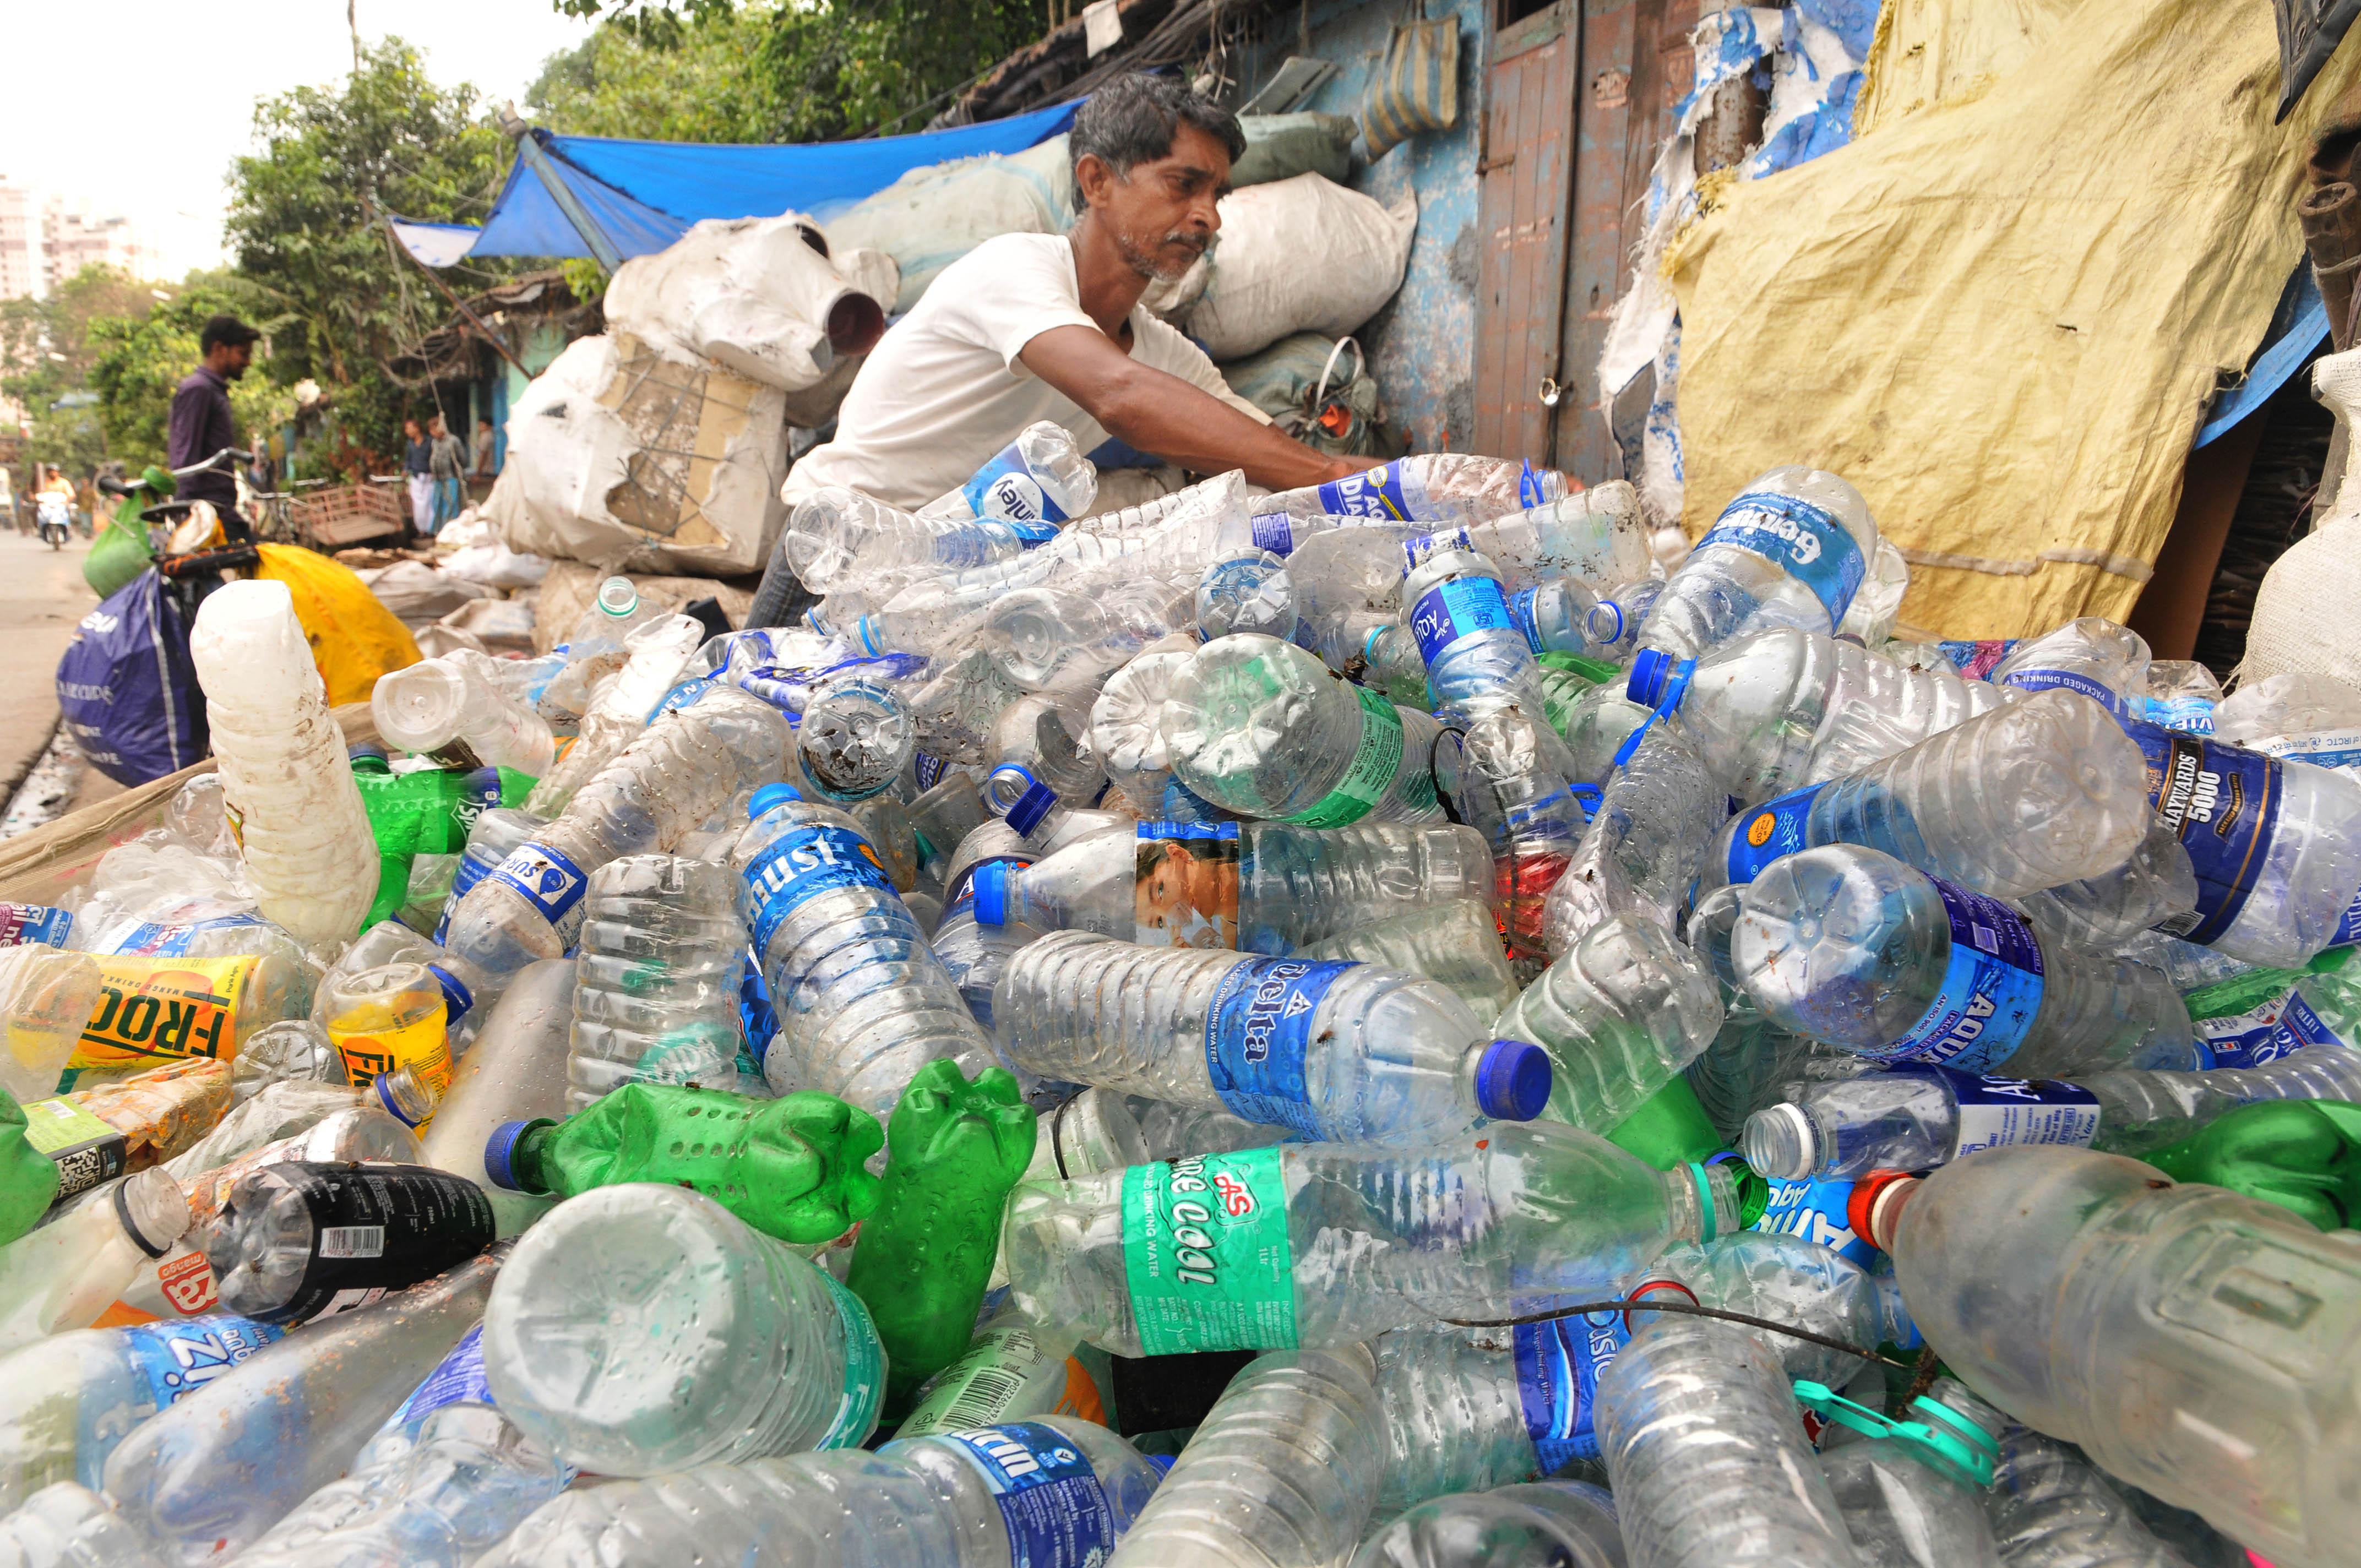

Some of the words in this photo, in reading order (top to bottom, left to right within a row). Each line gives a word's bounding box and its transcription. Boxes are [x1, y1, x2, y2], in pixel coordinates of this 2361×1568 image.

[2012, 674, 2060, 684] DRINKING
[2064, 678, 2105, 701] PACKAGED
[2327, 737, 2351, 746] IRCTC
[2186, 771, 2221, 823] 5000
[113, 976, 140, 989] DRINK
[145, 983, 180, 995] MANGO
[1210, 987, 1228, 1028] DRINKING
[1938, 993, 1947, 1006] AN
[1928, 1005, 1942, 1019] ISO
[1916, 1019, 1930, 1033] 9001
[1209, 1029, 1218, 1064] WATER
[1143, 1190, 1156, 1237] DRINKING
[162, 1254, 202, 1277] mango
[1147, 1239, 1160, 1277] WATER
